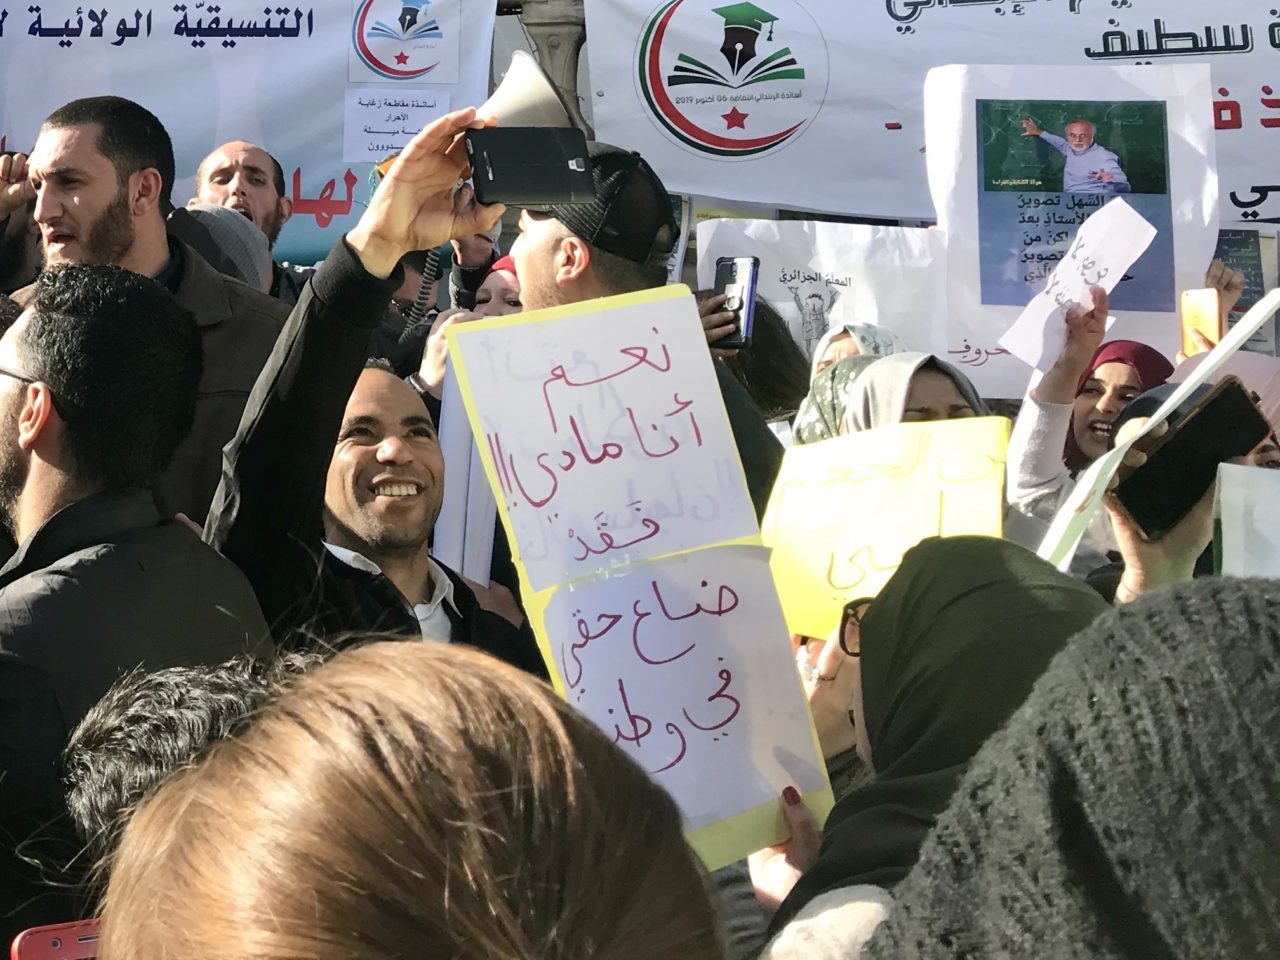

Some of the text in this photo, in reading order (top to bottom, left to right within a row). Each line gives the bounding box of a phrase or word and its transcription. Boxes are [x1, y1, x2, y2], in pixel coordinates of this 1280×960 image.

[1084, 18, 1254, 67] سطيف
[675, 97, 693, 105] 2019
[541, 326, 673, 433] نعم
[632, 577, 740, 666] ضاع
[683, 657, 742, 744] في
